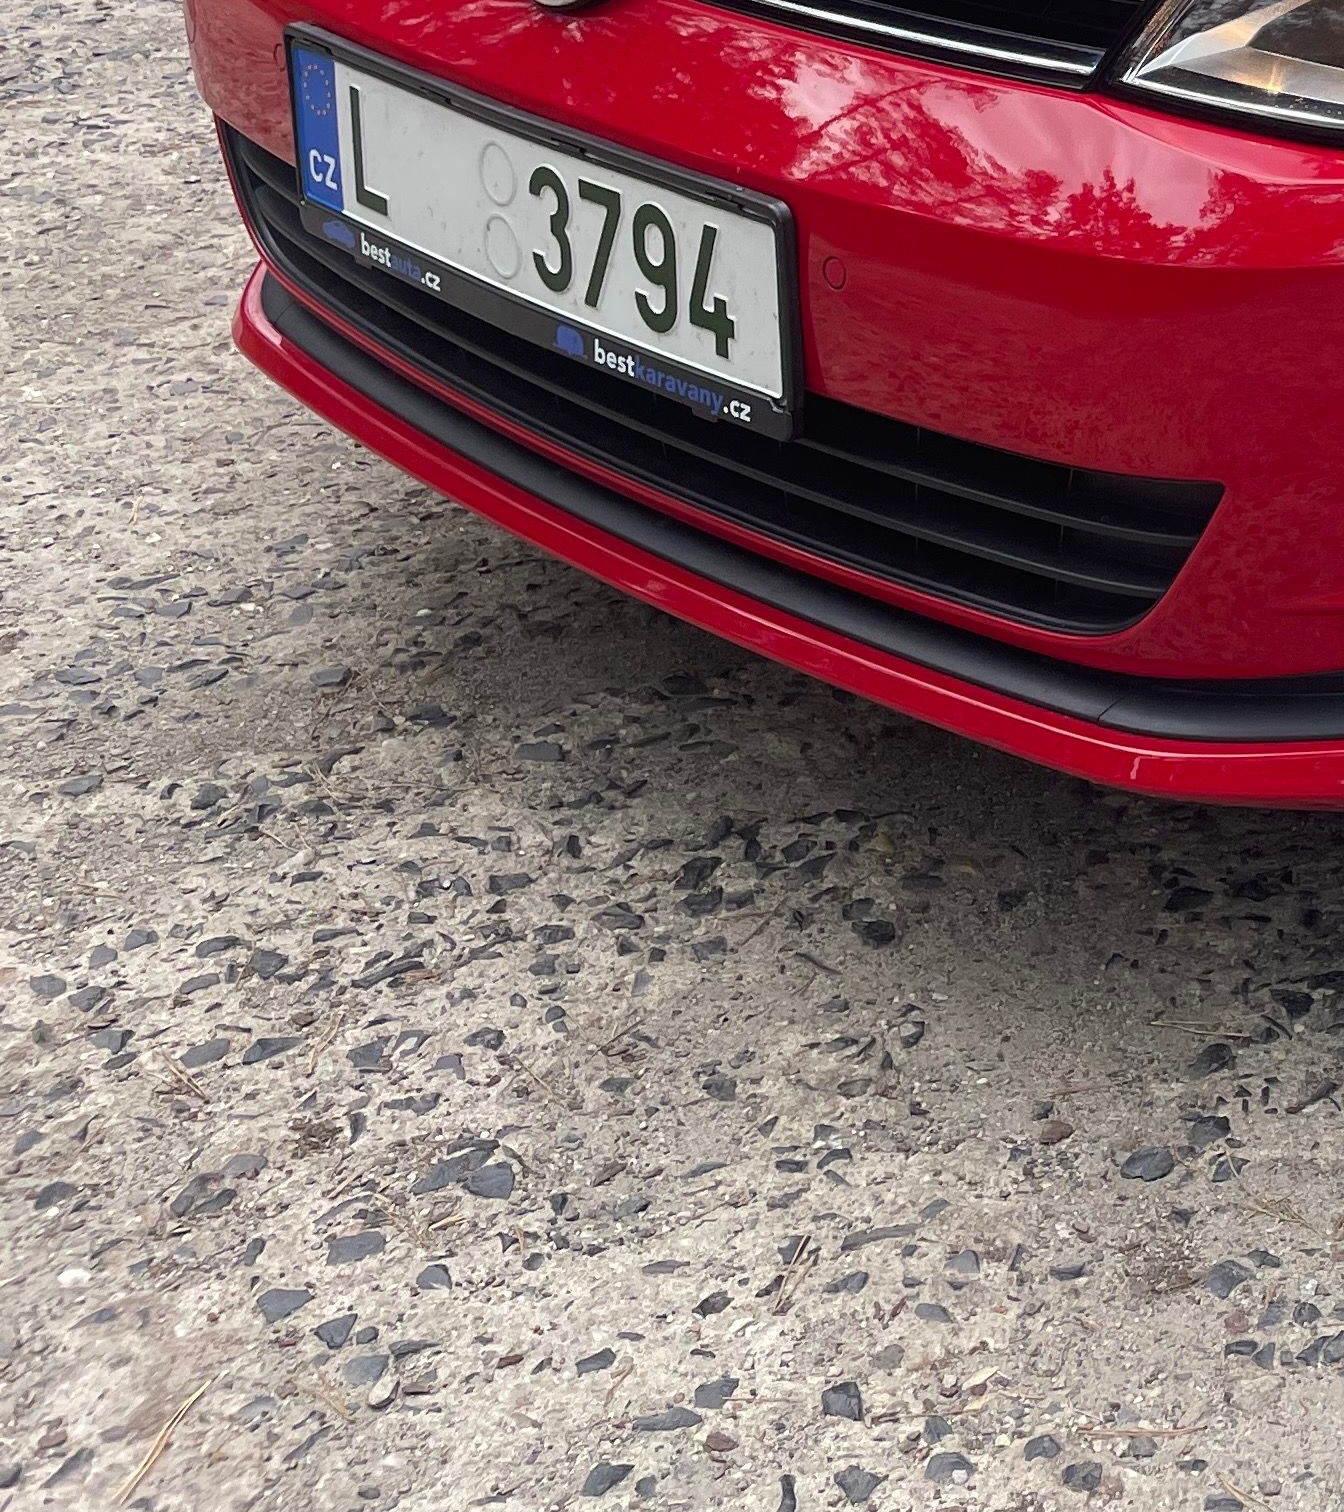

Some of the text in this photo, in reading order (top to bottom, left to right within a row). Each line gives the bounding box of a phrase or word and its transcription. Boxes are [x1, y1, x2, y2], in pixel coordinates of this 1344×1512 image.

[309, 148, 338, 191] CZ
[360, 231, 442, 292] bestauta.cz
[528, 164, 738, 360] 3794
[593, 338, 752, 423] bestkaravany.cz
